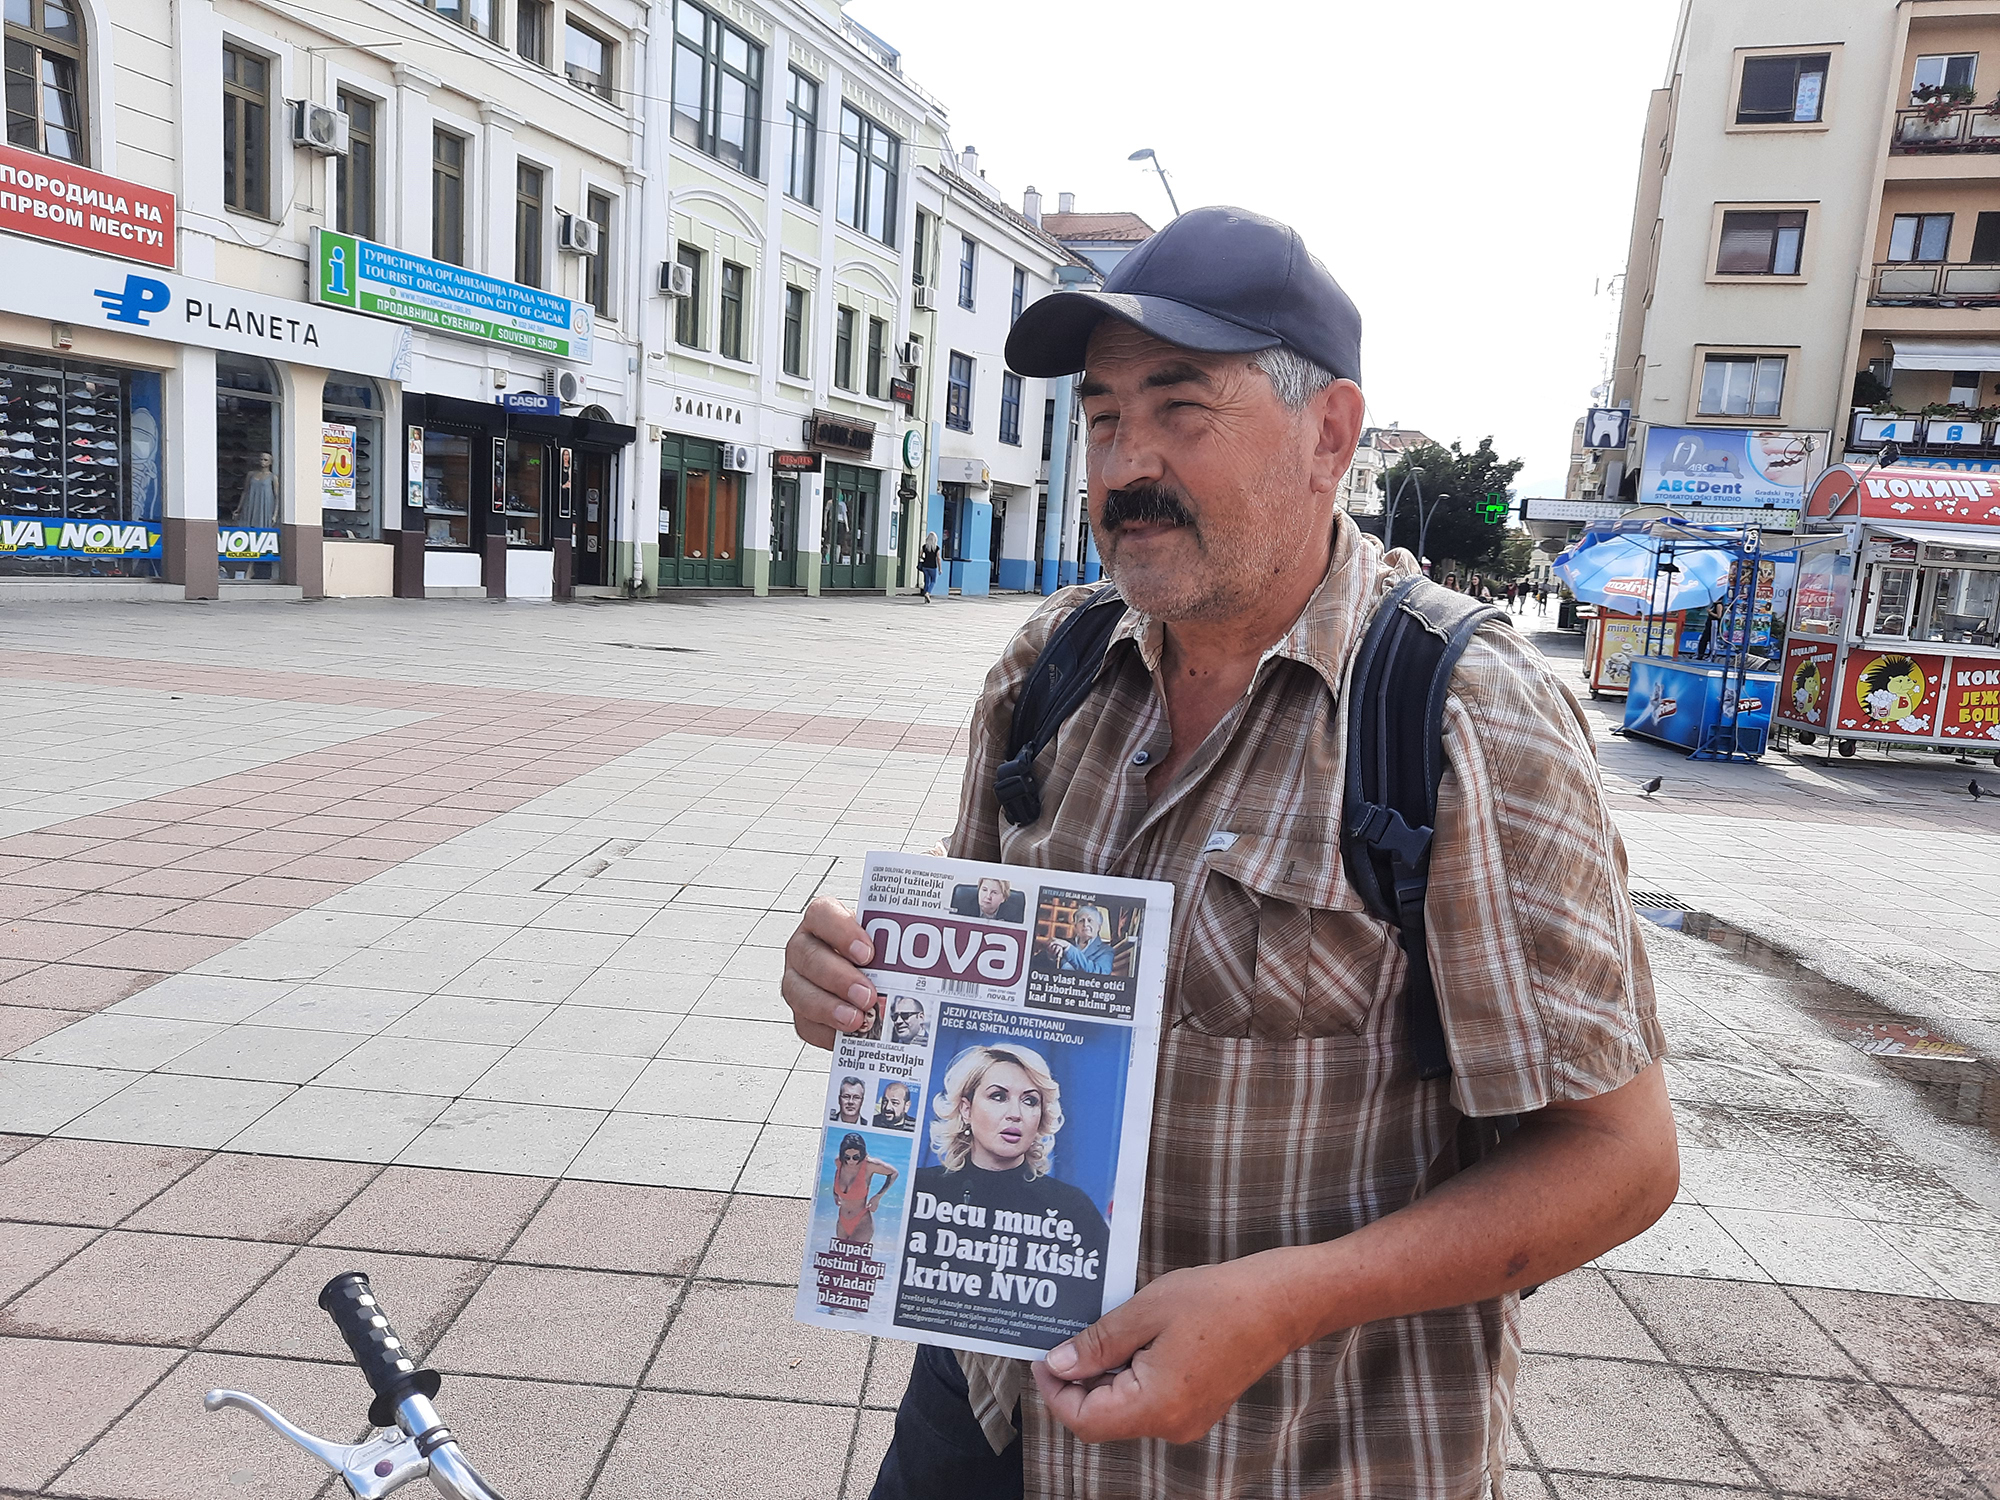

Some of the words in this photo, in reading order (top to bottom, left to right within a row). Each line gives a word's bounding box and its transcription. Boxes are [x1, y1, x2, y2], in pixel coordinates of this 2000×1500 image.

[0, 163, 129, 216] ПОРОДИЦА
[134, 201, 164, 224] НА
[0, 190, 83, 228] ПРВОМ
[89, 214, 164, 248] МЕСТУ!
[363, 247, 433, 277] ТУРИСТИЧКА
[508, 287, 536, 305] ГРАДА
[536, 295, 566, 313] ЧАЧКА
[364, 263, 415, 287] TOURIST
[416, 278, 494, 308] ORGANIZATION
[496, 298, 518, 313] CITY
[520, 304, 532, 317] OF
[533, 308, 565, 325] CACAK
[185, 298, 320, 348] PLANETA
[377, 298, 440, 324] ПРОДАВНИЦА
[441, 314, 486, 335] СУВЕНИРА
[498, 328, 536, 346] SOUVENIR
[538, 338, 558, 351] SHOP
[509, 395, 549, 409] CASIO
[1879, 423, 1896, 439] A
[1656, 479, 1742, 494] ABCDent
[1713, 494, 1742, 502] STUDIO
[1865, 479, 1994, 502] КОКИЦЕ
[60, 523, 149, 550] NOVA
[218, 531, 280, 554] NOVA
[84, 546, 124, 554] KOLEKCIJA
[1607, 623, 1630, 633] mini
[869, 883, 905, 895] skraćuju
[907, 888, 941, 899] mandat
[871, 873, 902, 885] Glavnoj
[904, 876, 944, 889] tužiteljki
[1042, 888, 1065, 897] INTERVJU
[868, 893, 877, 902] da
[879, 894, 887, 903] bi
[888, 894, 900, 905] joj
[902, 896, 920, 907] dali
[921, 899, 941, 909] novi
[865, 917, 1019, 980] nova
[916, 979, 927, 988] 29
[1030, 982, 1041, 991] na
[1045, 983, 1089, 998] izborima,
[1092, 990, 1116, 1002] nego
[1031, 970, 1050, 982] Ova
[1053, 973, 1076, 985] vlast
[1078, 976, 1101, 989] neće
[1103, 980, 1125, 991] otići
[987, 993, 1016, 1002] nova.rs
[1028, 991, 1047, 1002] kad
[1049, 994, 1062, 1005] im
[1065, 997, 1075, 1006] se
[1078, 998, 1107, 1011] ukinu
[1109, 1003, 1132, 1014] pare
[943, 1006, 969, 1018] JEZIV
[969, 1009, 1009, 1024] IZVEŠTAJ
[1010, 1015, 1017, 1025] O
[1018, 1016, 1066, 1032] TRETMANU
[942, 1017, 964, 1029] DECE
[965, 1020, 978, 1031] SA
[979, 1022, 1034, 1039] SMETNJAMA
[1035, 1029, 1042, 1040] U
[1043, 1031, 1084, 1046] RAZVOJU
[838, 1057, 865, 1071] Srbiju
[869, 1063, 875, 1071] u
[879, 1062, 913, 1078] Evropi
[840, 1045, 856, 1057] Oni
[858, 1049, 925, 1067] predstavljaju
[913, 1191, 987, 1229] Decu
[993, 1208, 1082, 1248] muče,
[830, 1238, 873, 1257] Kupaći
[908, 1230, 928, 1254] a
[933, 1228, 1019, 1272] Dariji
[1024, 1242, 1099, 1280] Kisić
[813, 1252, 859, 1273] kostimi
[860, 1260, 886, 1278] koji
[817, 1270, 830, 1285] će
[832, 1274, 876, 1293] vladati
[903, 1257, 983, 1297] krive
[988, 1270, 1058, 1309] NVO
[817, 1289, 870, 1310] plažama
